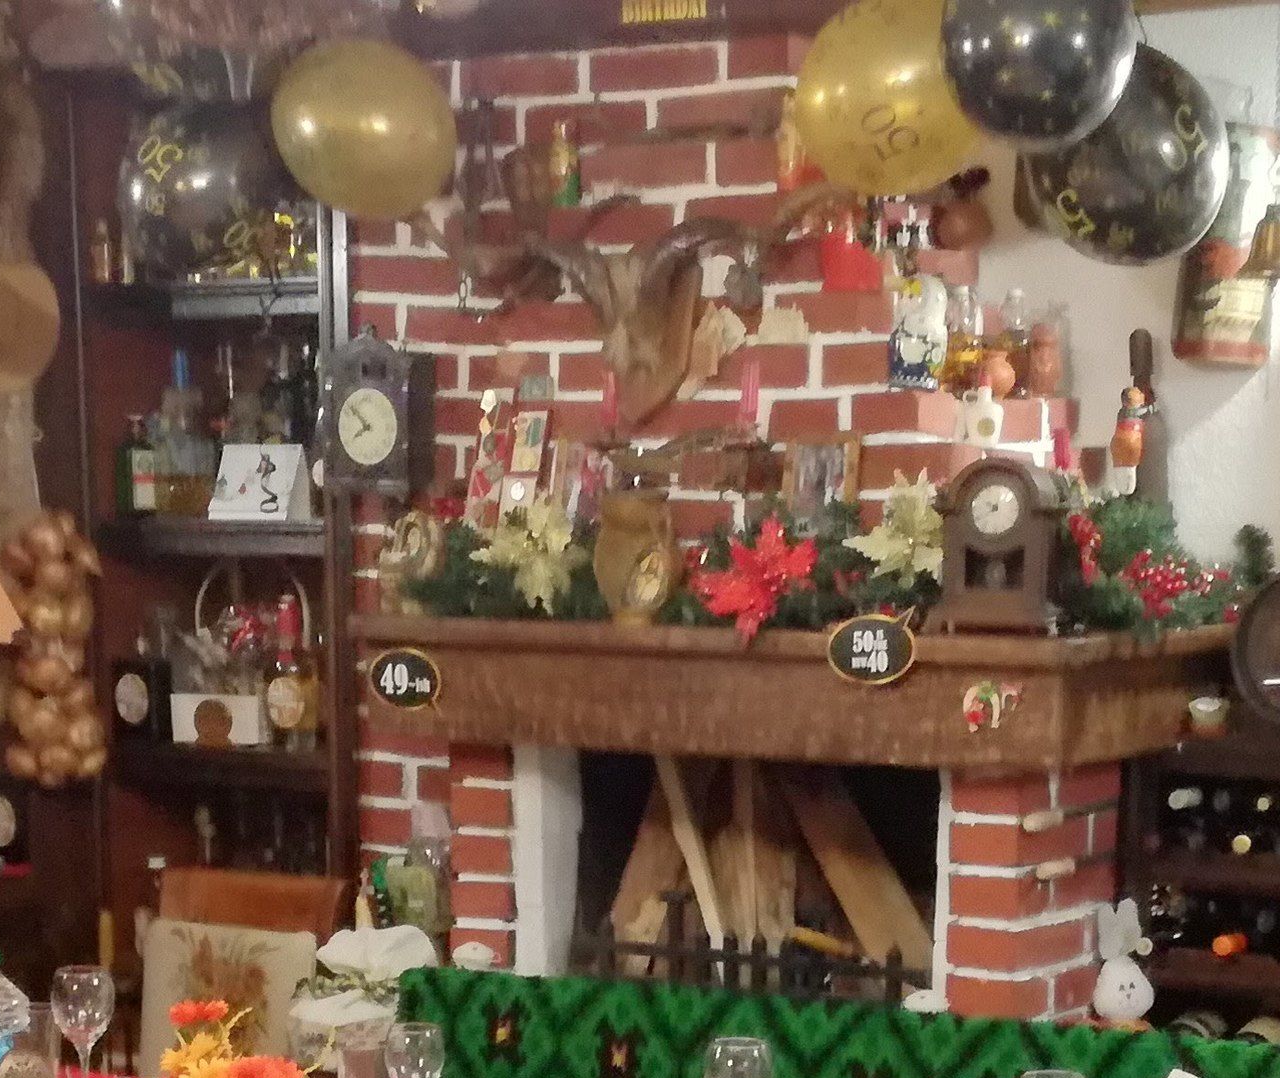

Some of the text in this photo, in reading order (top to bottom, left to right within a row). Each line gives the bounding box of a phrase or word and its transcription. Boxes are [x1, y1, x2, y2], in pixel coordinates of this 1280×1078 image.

[861, 104, 920, 162] 50
[137, 135, 184, 182] 50
[852, 630, 874, 654] 50
[867, 650, 889, 673] 40
